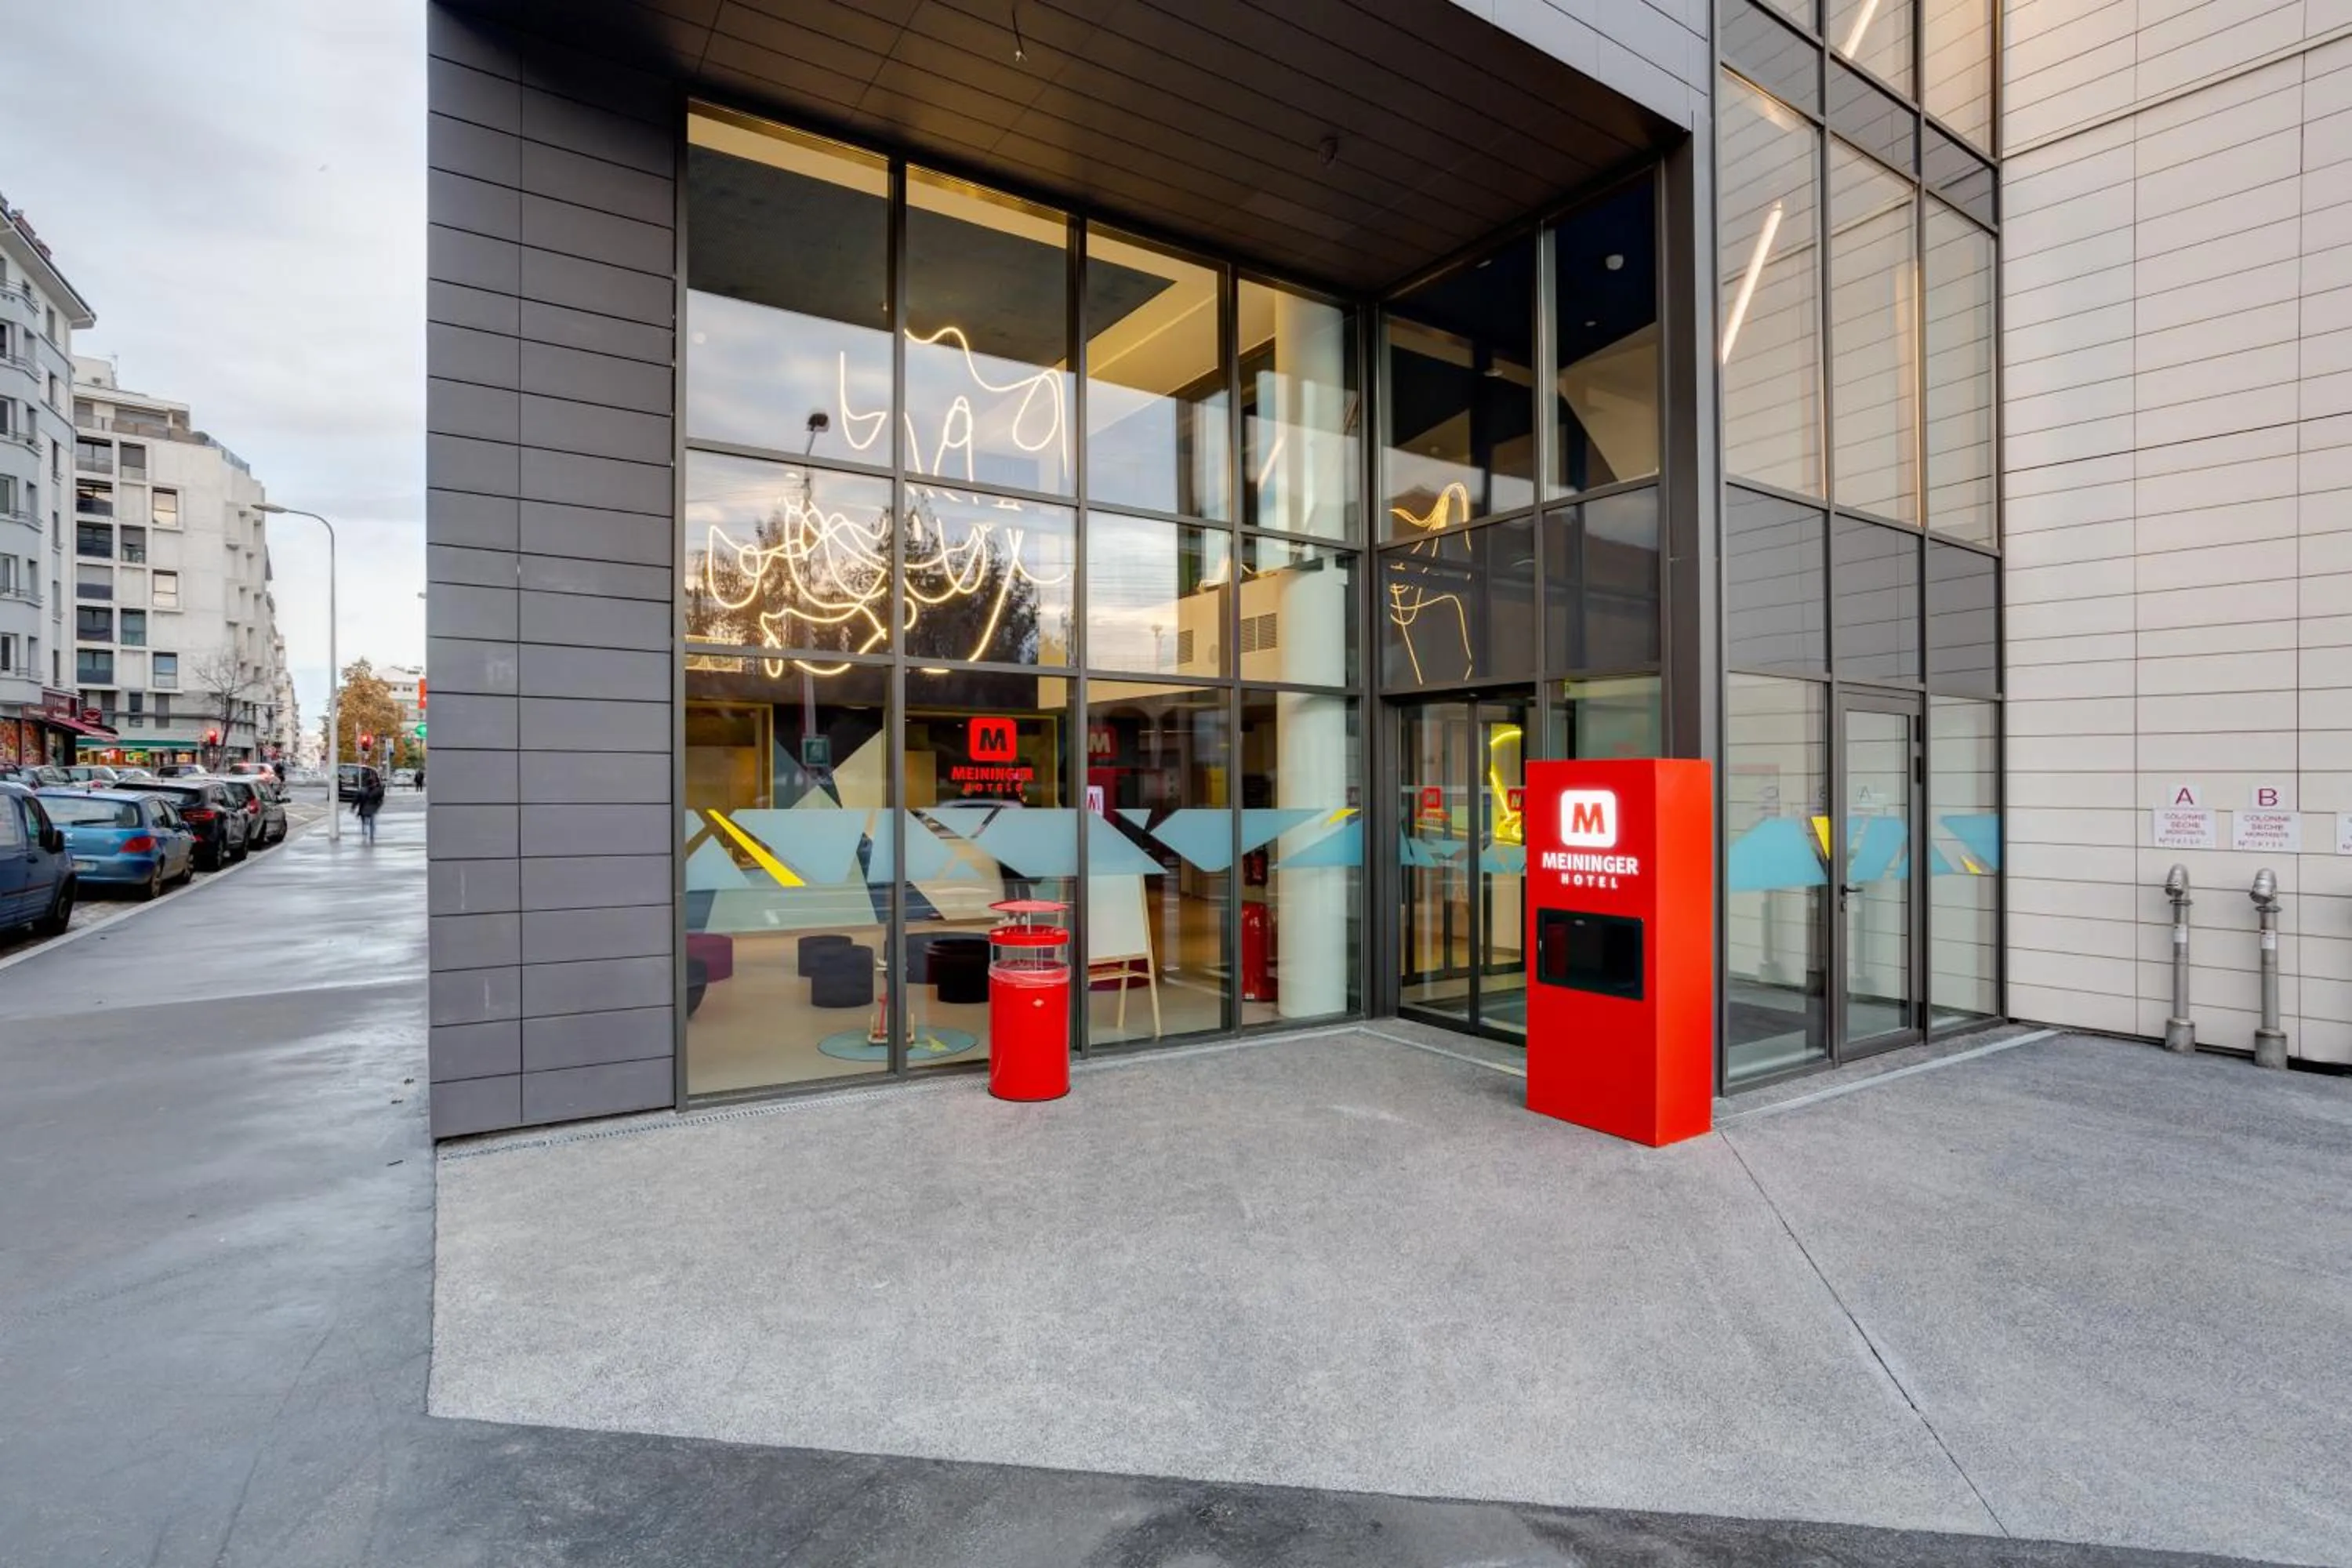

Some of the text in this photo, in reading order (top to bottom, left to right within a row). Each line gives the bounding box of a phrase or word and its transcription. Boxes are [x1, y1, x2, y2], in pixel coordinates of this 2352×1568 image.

[980, 727, 1007, 752] M
[2176, 787, 2194, 805] A
[2259, 787, 2278, 807] B
[1571, 802, 1606, 834] M
[1542, 851, 1639, 875] MEININGER
[1561, 873, 1618, 888] HOTEL
